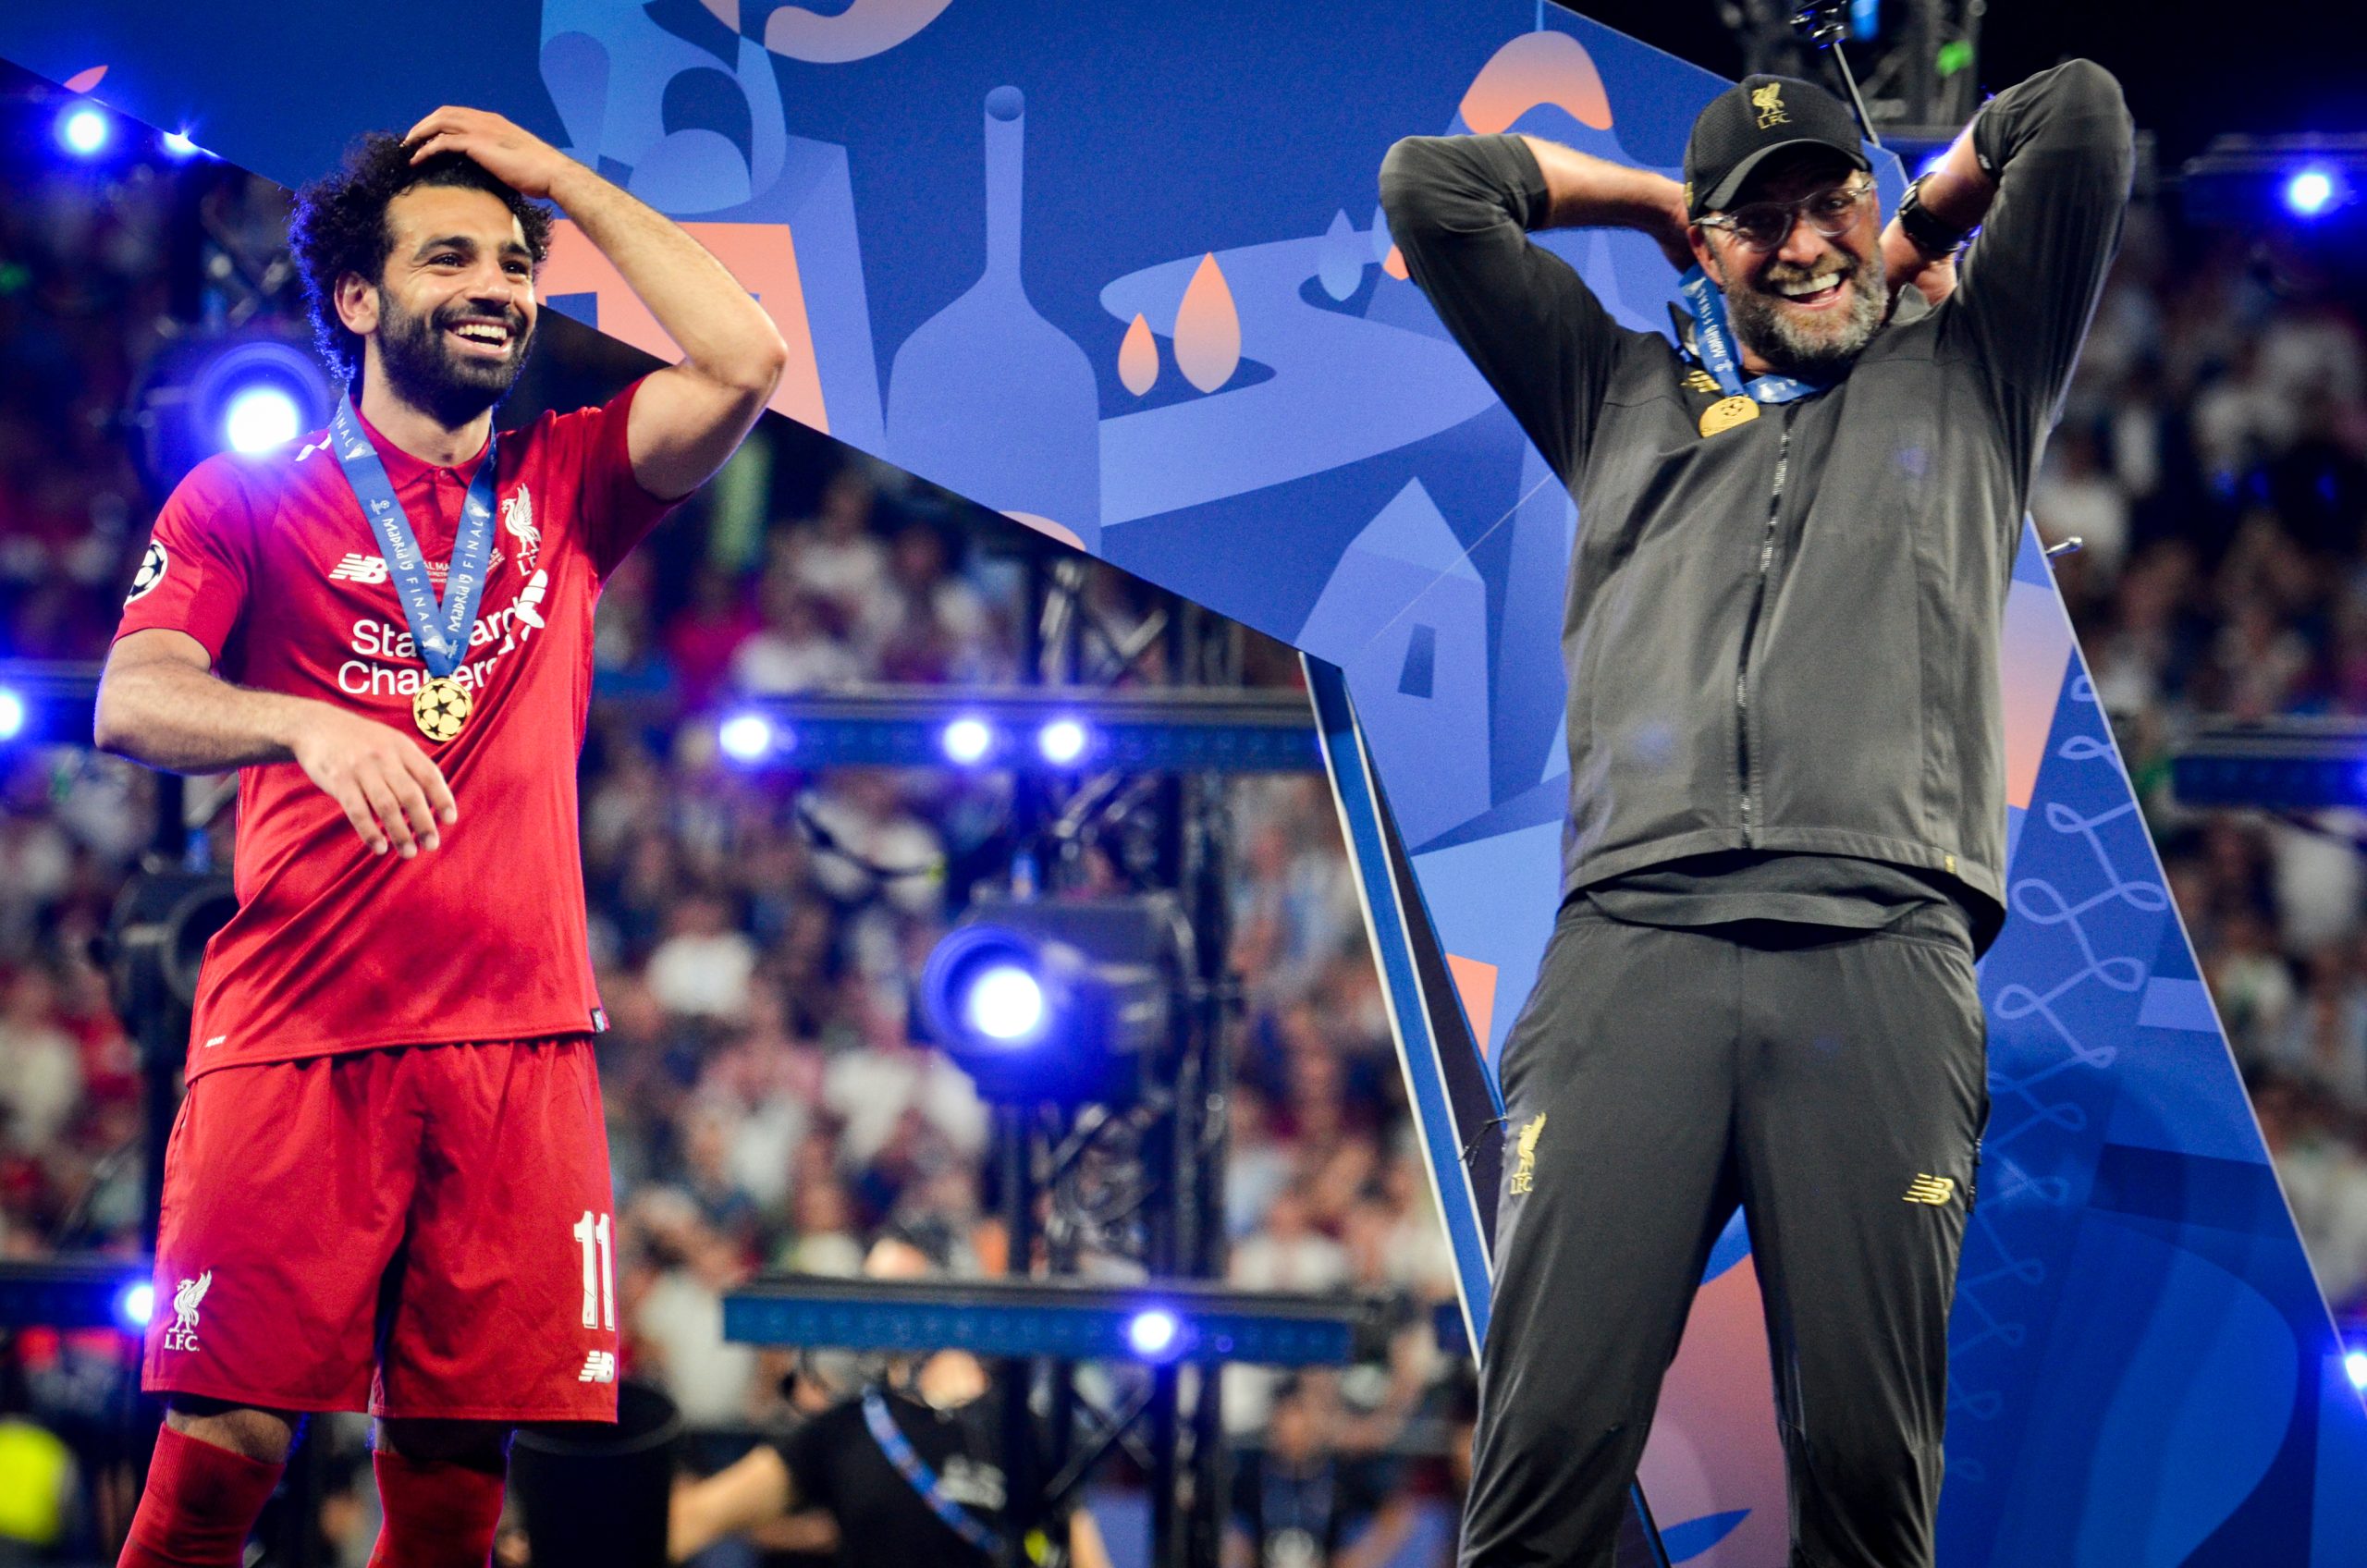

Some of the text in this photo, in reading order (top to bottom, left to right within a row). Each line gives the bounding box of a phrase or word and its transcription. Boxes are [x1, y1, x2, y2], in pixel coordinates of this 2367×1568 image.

[1757, 113, 1792, 129] LFC
[463, 521, 484, 569] FINAL
[406, 577, 435, 633] FINAL
[573, 1210, 615, 1332] 11
